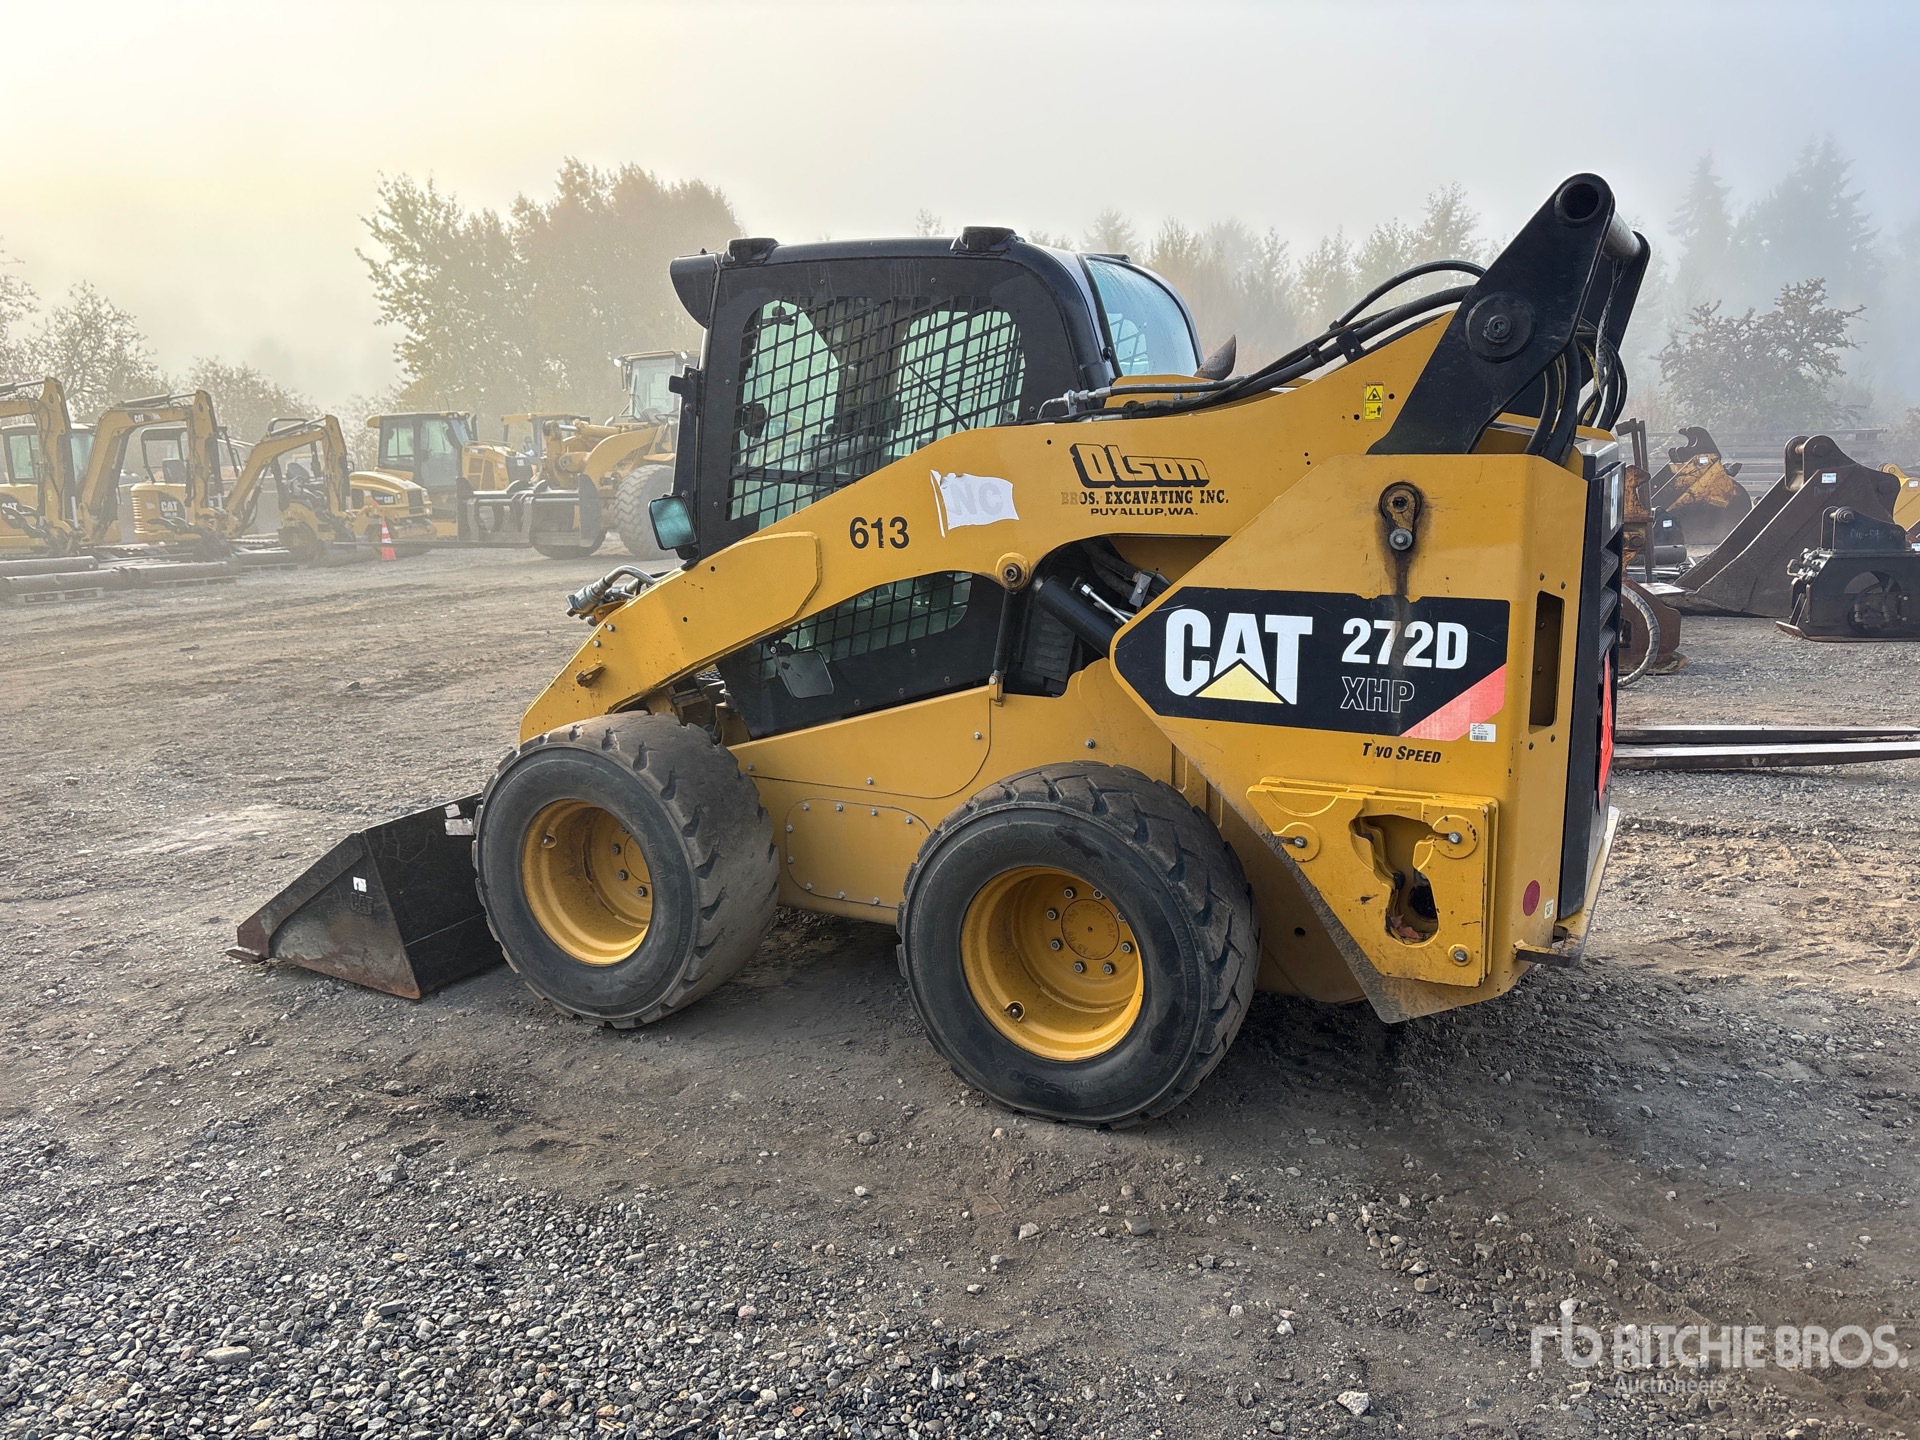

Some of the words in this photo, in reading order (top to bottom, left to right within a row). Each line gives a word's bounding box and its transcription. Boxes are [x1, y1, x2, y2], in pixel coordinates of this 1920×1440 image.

[1069, 443, 1210, 488] Olson
[161, 501, 177, 511] CAT
[1105, 490, 1193, 505] EXCAVATING
[1200, 489, 1229, 504] INC.
[849, 517, 909, 549] 613
[1165, 608, 1313, 705] CAT
[1341, 617, 1469, 670] 272D
[1340, 676, 1415, 713] XHP
[1395, 745, 1442, 763] SPEED
